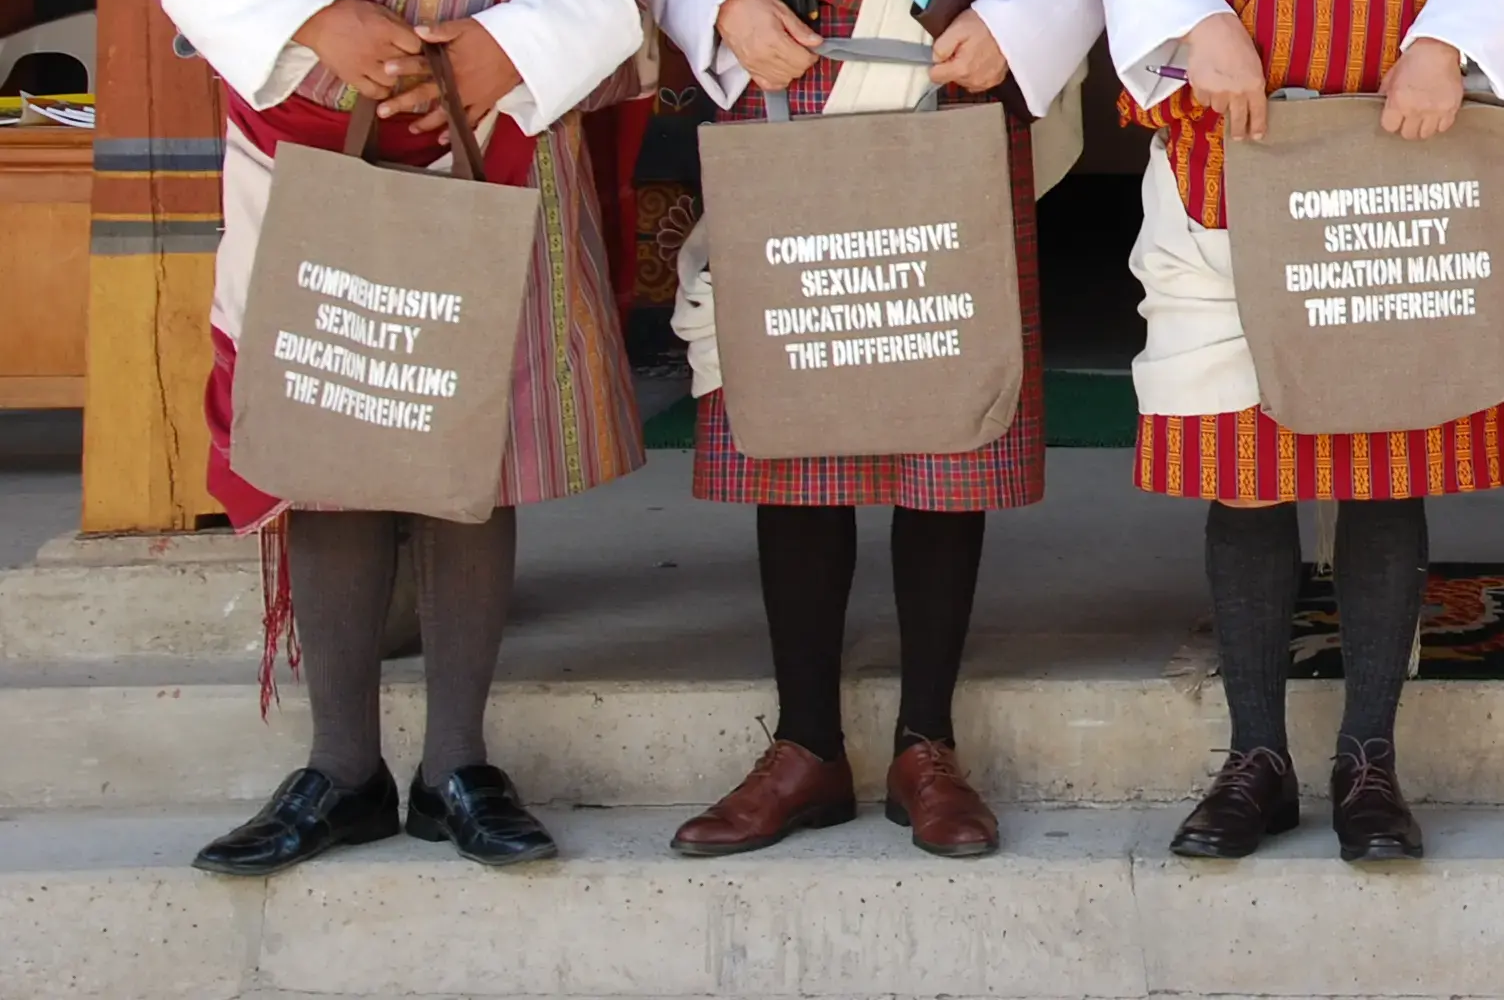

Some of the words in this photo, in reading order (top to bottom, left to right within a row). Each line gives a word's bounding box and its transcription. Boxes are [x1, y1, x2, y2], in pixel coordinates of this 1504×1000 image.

[1289, 180, 1480, 220] COMPREHENSIVE
[765, 222, 960, 265] COMPREHENSIVE
[1324, 217, 1449, 253] SEXUALITY
[298, 260, 462, 323] COMPREHENSIVE
[801, 260, 927, 297] SEXUALITY
[1285, 257, 1402, 292] EDUCATION
[1407, 251, 1491, 284] MAKING
[315, 303, 421, 354] SEXUALITY
[764, 302, 882, 336] EDUCATION
[886, 292, 974, 327] MAKING
[1304, 297, 1347, 327] THE
[1351, 288, 1476, 324] DIFFERENCE
[274, 330, 366, 383] EDUCATION
[368, 358, 458, 397] MAKING
[785, 341, 828, 370] THE
[832, 329, 961, 367] DIFFERENCE
[284, 370, 319, 405] THE
[320, 381, 433, 432] DIFFERENCE
